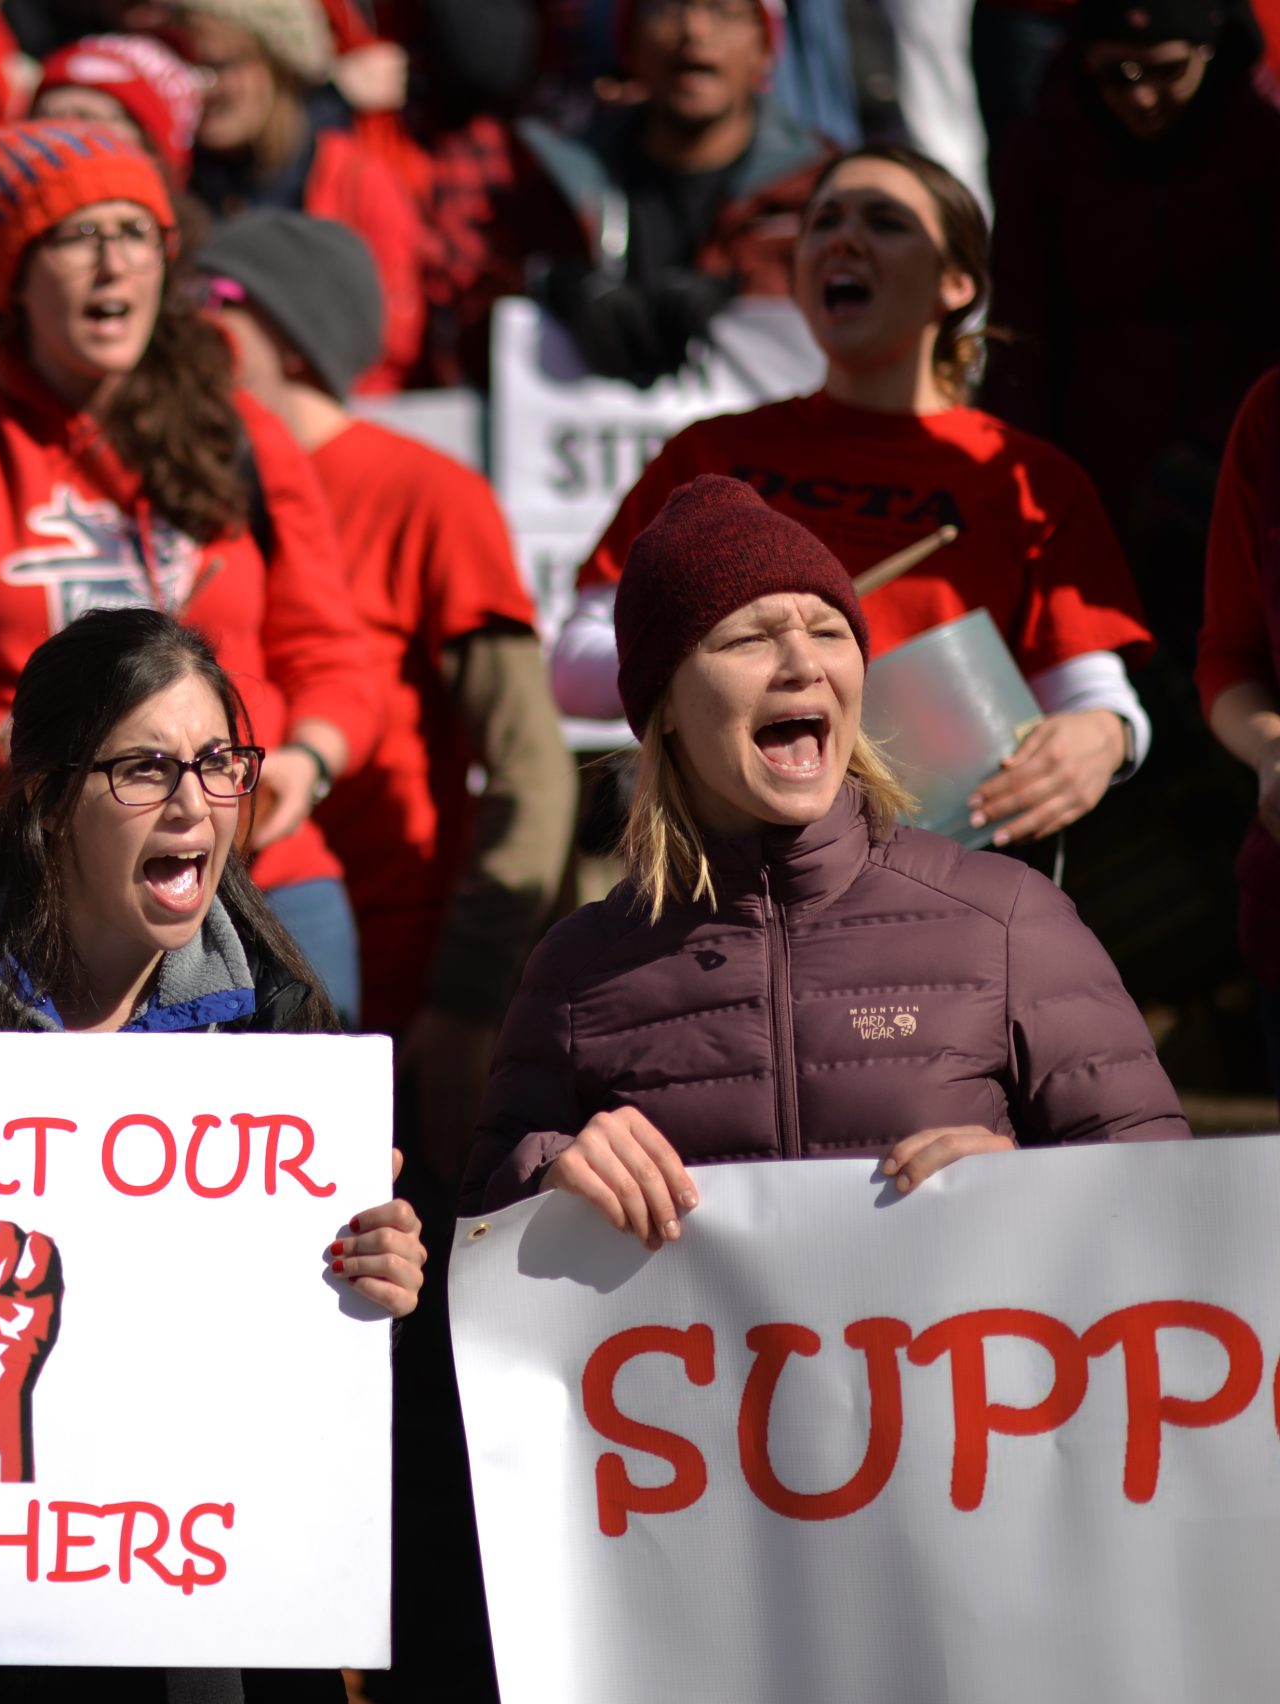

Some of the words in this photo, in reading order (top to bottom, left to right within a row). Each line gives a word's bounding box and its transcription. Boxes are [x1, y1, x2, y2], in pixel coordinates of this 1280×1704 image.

[849, 1005, 920, 1016] MOUNTAIN
[852, 1015, 886, 1029] HARD
[860, 1026, 895, 1041] WEAR
[102, 1113, 336, 1199] OUR
[583, 1300, 1280, 1538] SUPP
